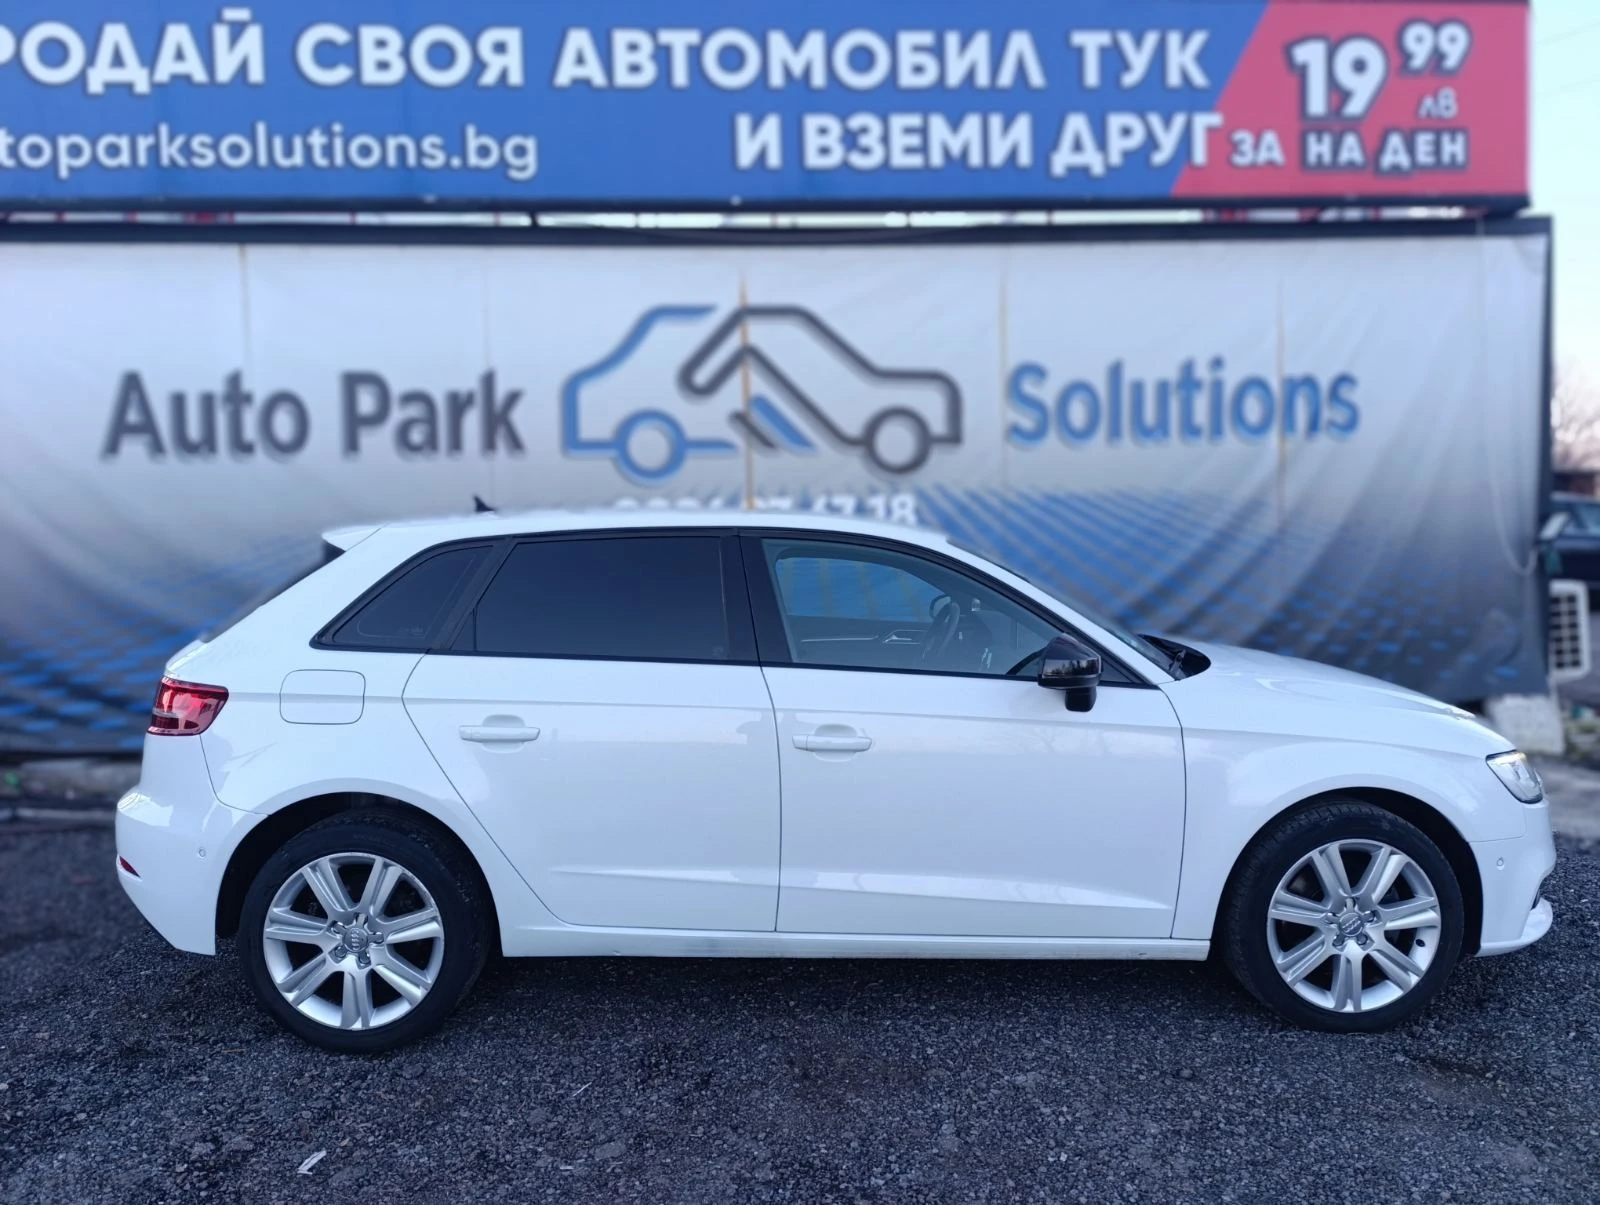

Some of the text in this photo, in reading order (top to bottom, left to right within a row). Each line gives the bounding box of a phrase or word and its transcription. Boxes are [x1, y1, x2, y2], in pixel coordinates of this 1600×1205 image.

[296, 24, 523, 87] СВОЯ
[552, 28, 1047, 89] АВТОМОБИЛ
[1070, 30, 1210, 89] ТУК
[1288, 20, 1472, 120] 19 99
[734, 112, 1286, 177] И ВЗЕМИ ДРУГ ЗА
[1304, 129, 1468, 173] НА ДЕН
[102, 367, 526, 458] Auto Park
[1004, 354, 1362, 447] Solutions
